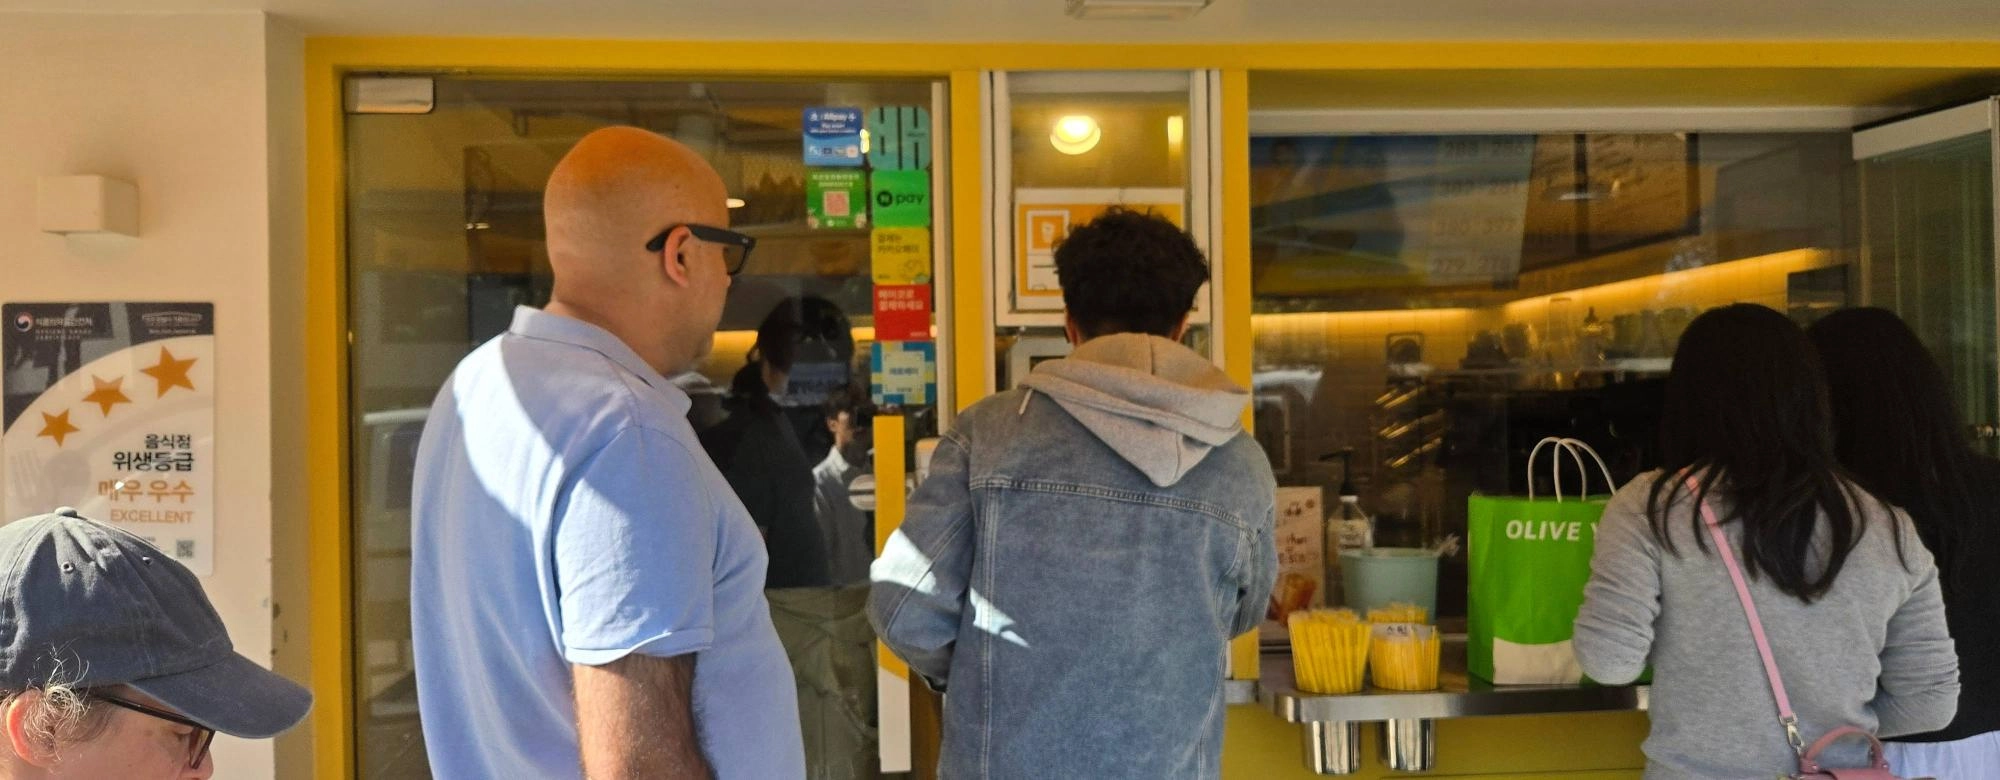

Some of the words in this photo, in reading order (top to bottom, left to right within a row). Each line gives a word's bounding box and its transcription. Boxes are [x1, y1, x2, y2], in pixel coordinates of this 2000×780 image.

[896, 194, 925, 204] pay
[145, 434, 191, 449] 음식점
[113, 452, 195, 472] 위생등급
[98, 480, 143, 502] 매우
[147, 480, 195, 503] 우수
[110, 510, 194, 523] EXCELLENT
[1506, 520, 1581, 541] OLIVE
